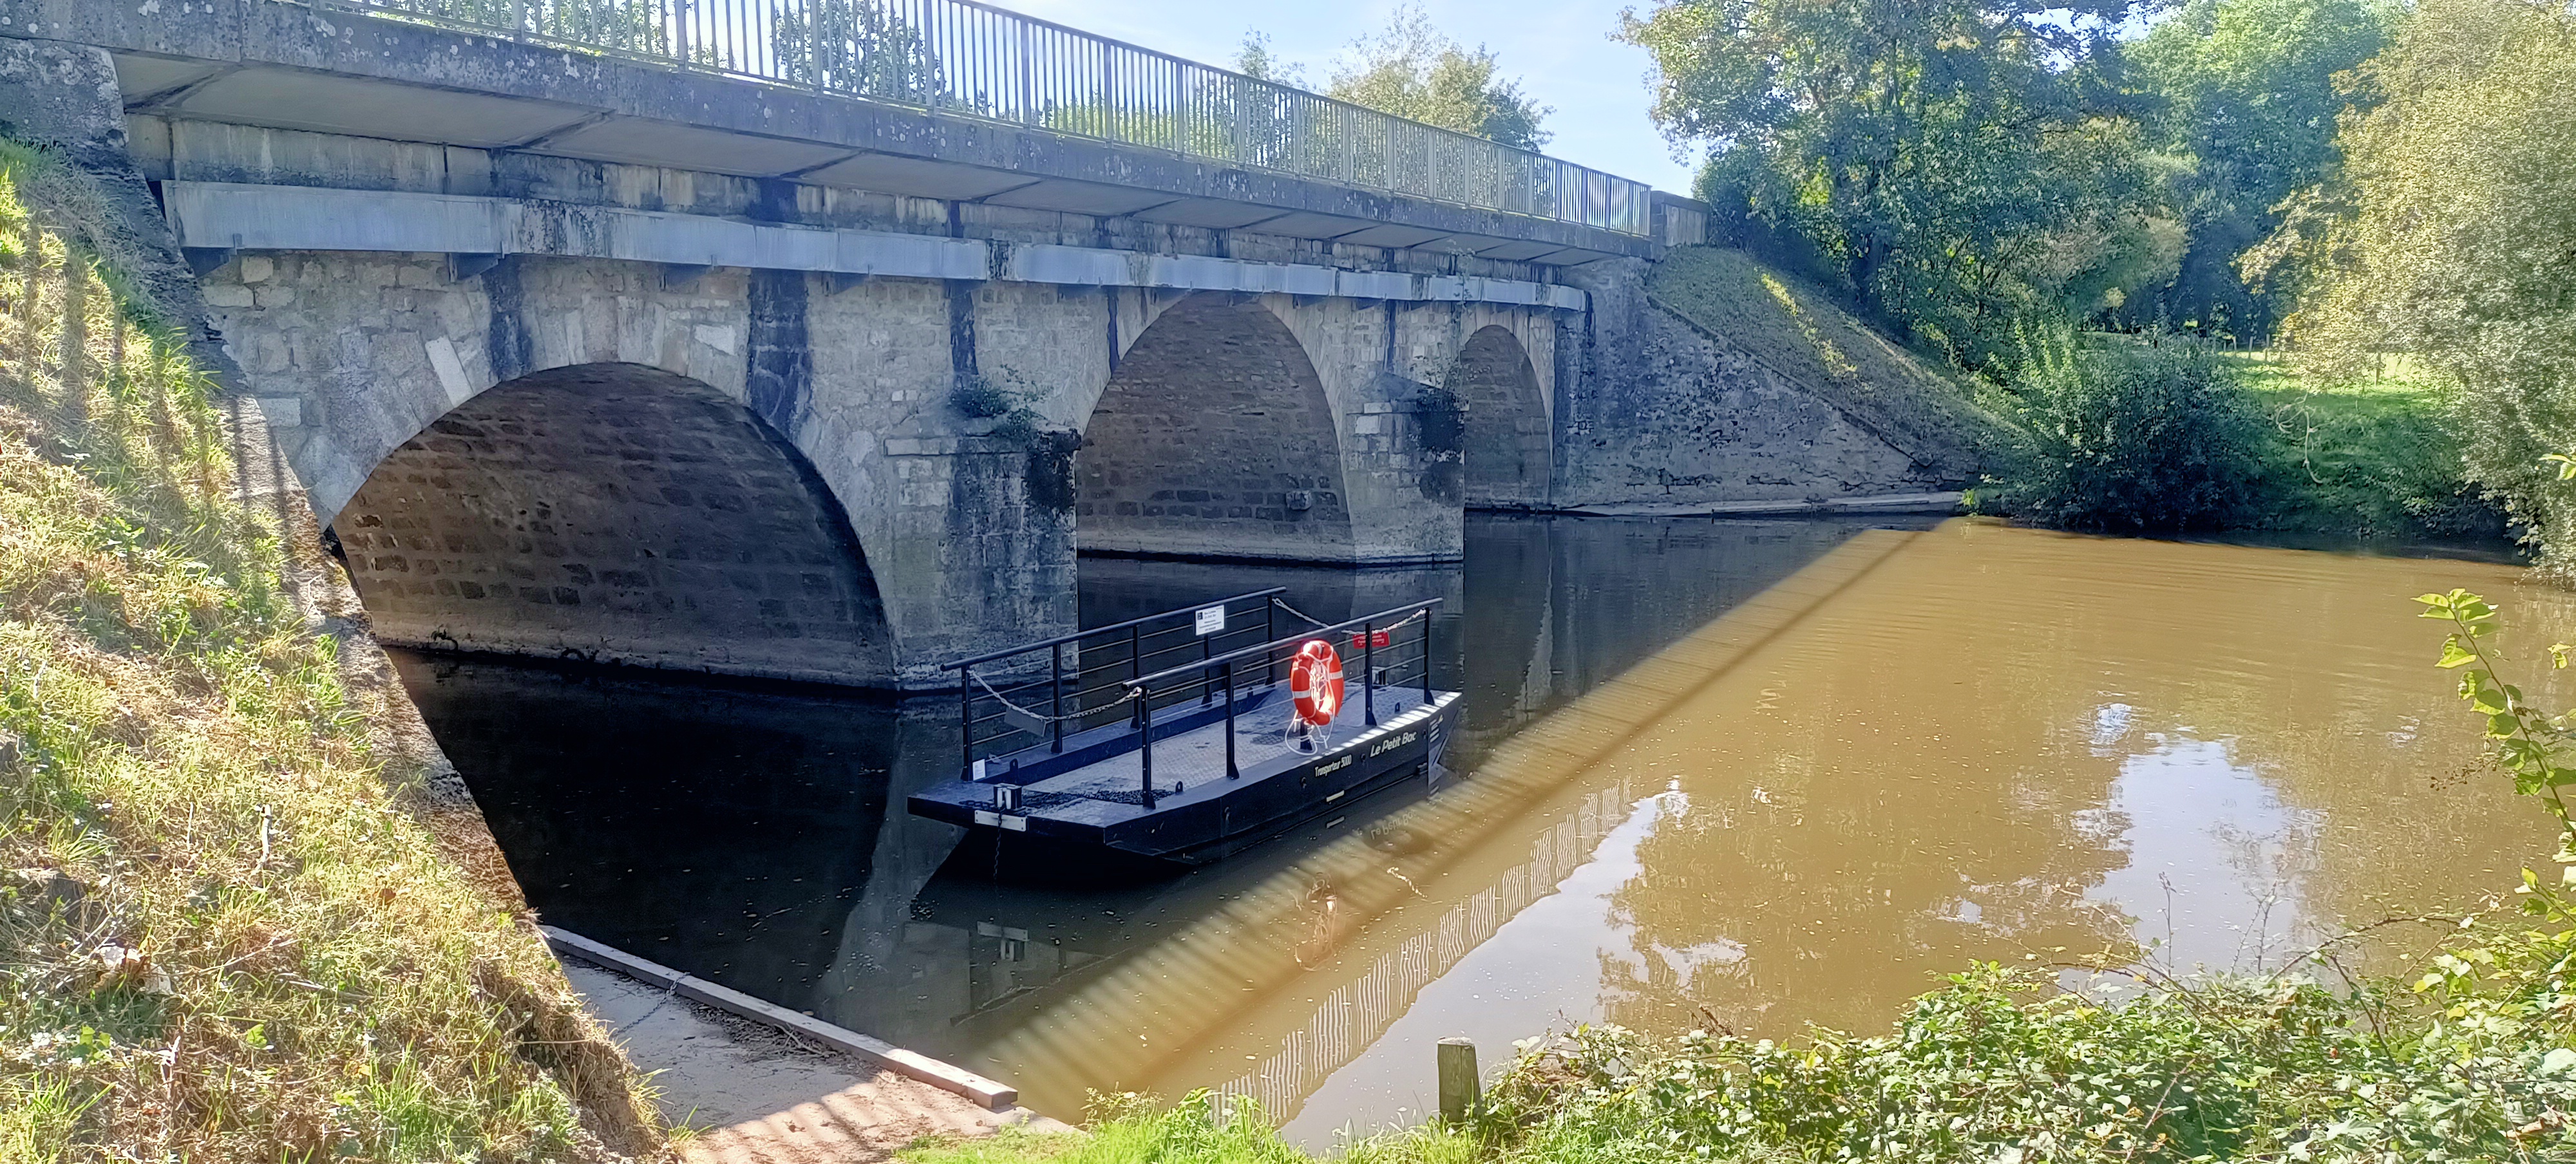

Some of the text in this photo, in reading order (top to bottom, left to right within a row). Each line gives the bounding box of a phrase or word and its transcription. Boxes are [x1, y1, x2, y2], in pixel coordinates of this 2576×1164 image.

[1370, 731, 1417, 757] Le Petit Bac
[1314, 755, 1352, 777] Transporteur 5000
